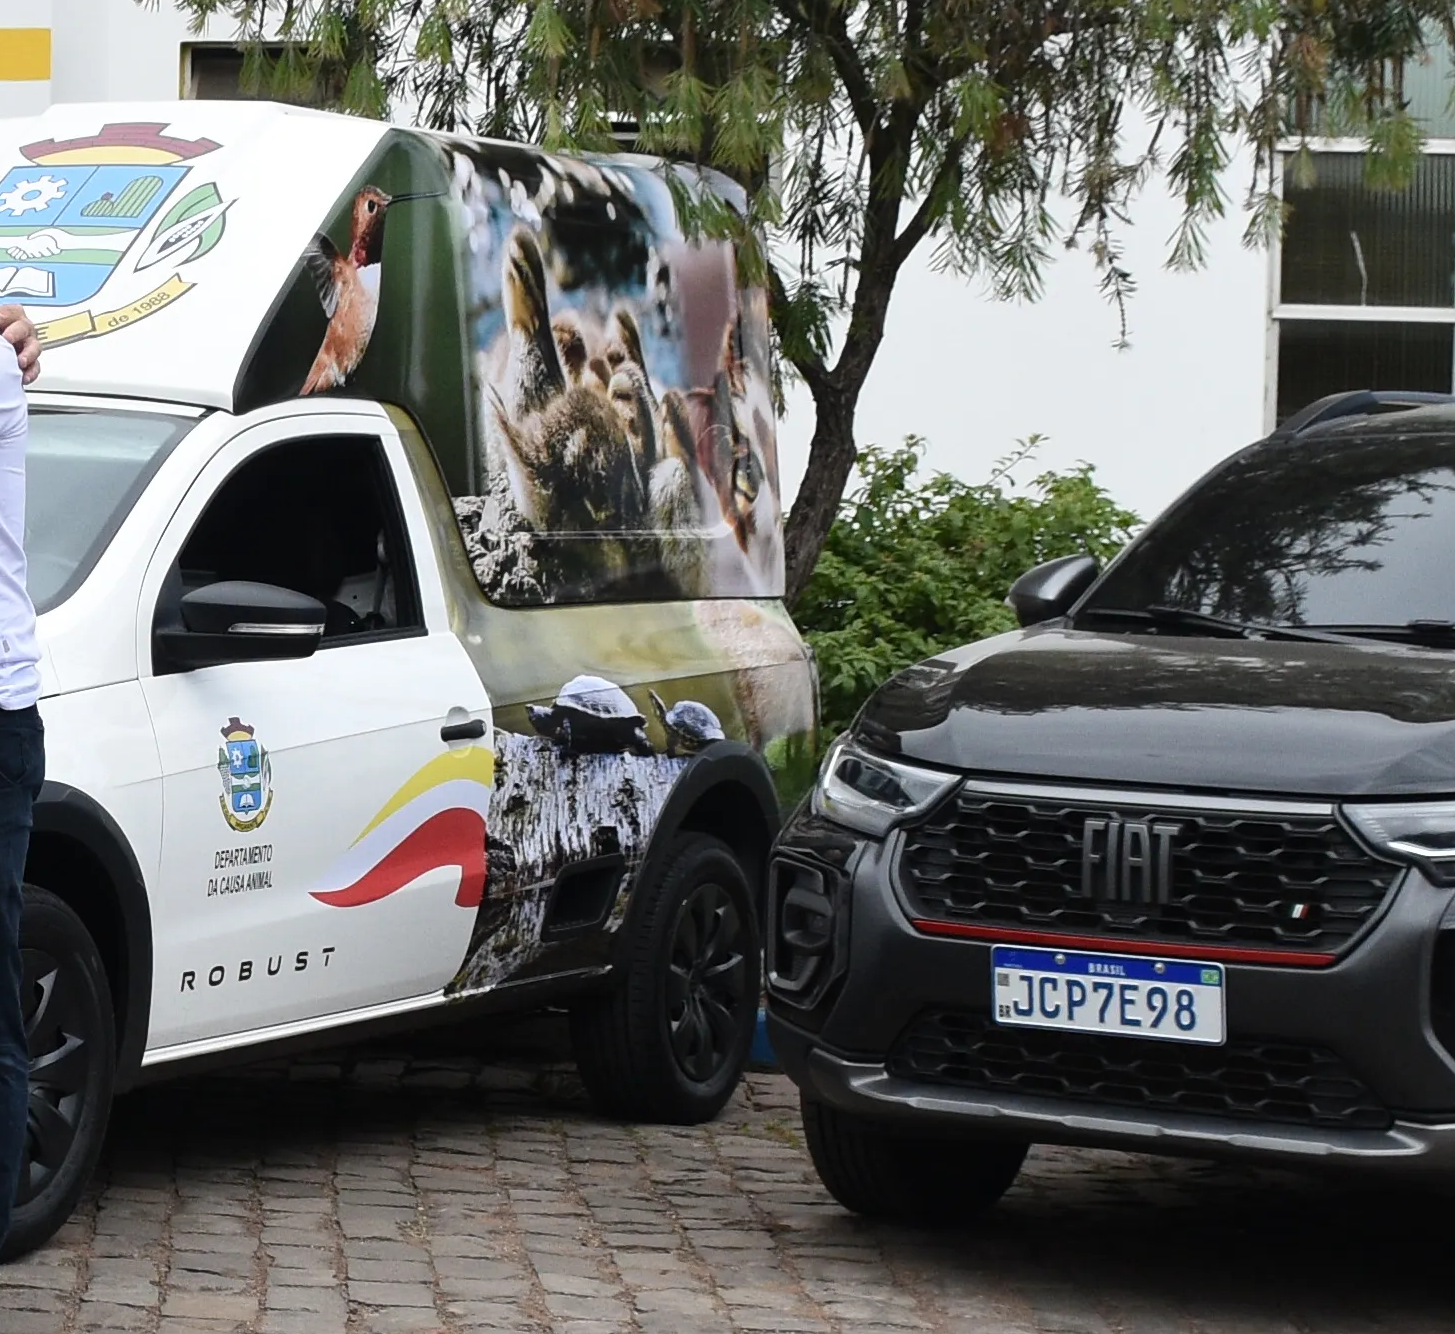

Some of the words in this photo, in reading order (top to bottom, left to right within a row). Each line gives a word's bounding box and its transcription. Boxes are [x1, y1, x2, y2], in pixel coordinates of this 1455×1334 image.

[107, 314, 130, 327] de
[131, 291, 171, 315] 1988
[215, 844, 273, 869] DEPARTAMENTO
[1081, 818, 1183, 905] FIAT
[207, 878, 218, 897] DA
[220, 873, 245, 895] CAUSA
[245, 871, 273, 891] ANIMAL
[180, 946, 336, 992] ROBUST
[1087, 962, 1126, 976] BRASIL
[1012, 974, 1197, 1031] JCP7E98
